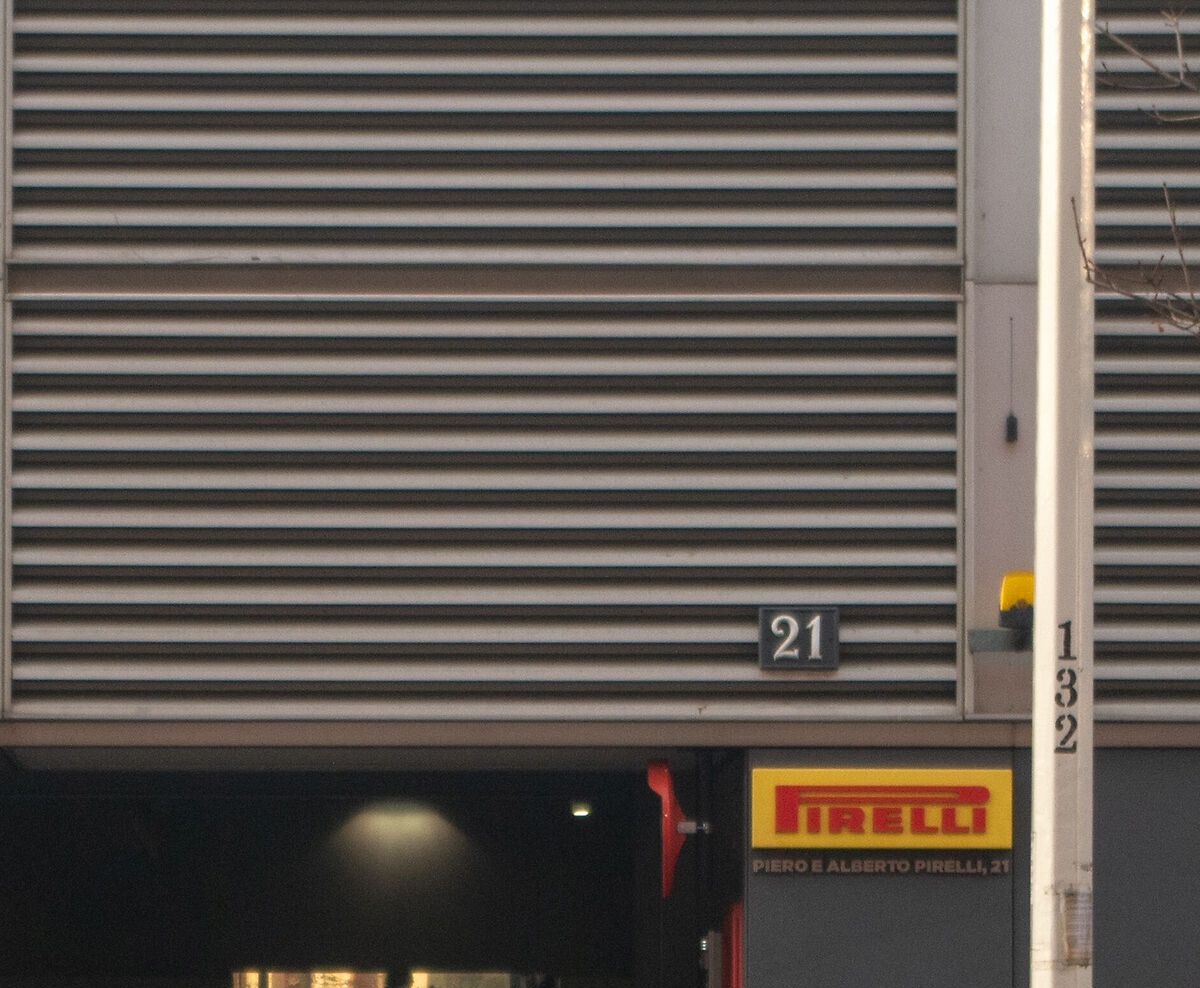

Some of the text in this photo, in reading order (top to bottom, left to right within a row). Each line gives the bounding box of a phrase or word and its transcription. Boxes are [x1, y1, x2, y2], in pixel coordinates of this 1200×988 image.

[770, 614, 823, 662] 21
[1053, 619, 1078, 754] 132
[775, 785, 990, 833] PIRELLI
[753, 859, 1010, 875] PIERO E ALBERTO PIRELLI, 21
